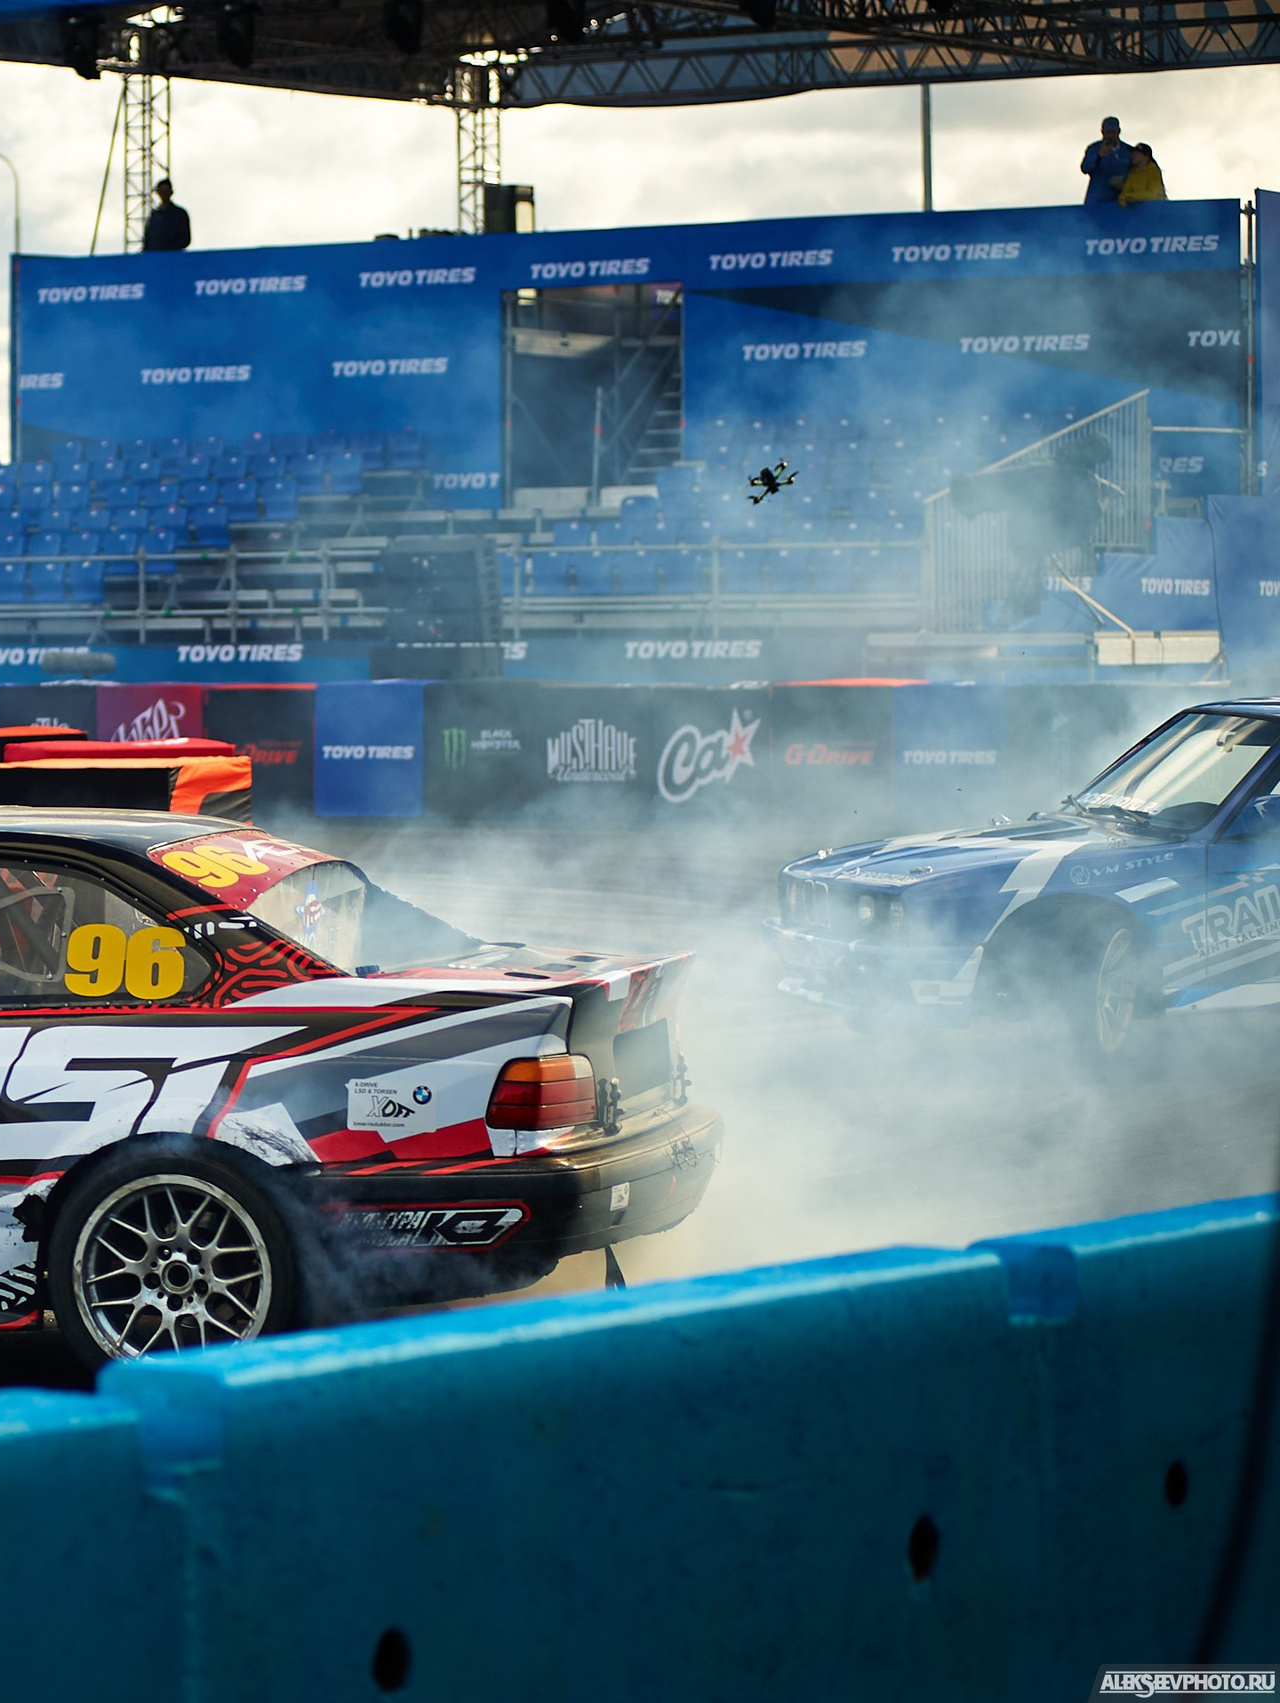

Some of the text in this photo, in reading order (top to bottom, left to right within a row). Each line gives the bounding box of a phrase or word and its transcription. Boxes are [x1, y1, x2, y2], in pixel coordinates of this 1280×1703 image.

[891, 242, 1021, 263] TOYO TIRES
[1085, 235, 1219, 255] TOYO TIRES
[530, 257, 651, 279] TOYO TIRES
[709, 249, 834, 271] TOYO TIRES
[194, 275, 308, 296] TOYO TIRES
[359, 266, 476, 288] TOYO TIRES
[37, 283, 146, 304] TOYO TIRES
[743, 340, 867, 361] TOYO TIRES
[959, 334, 1091, 353] TOYO TIRES
[141, 364, 253, 385] TOYO TIRES
[332, 357, 449, 377] TOYO TIRES
[433, 472, 486, 490] TOYO
[1141, 577, 1210, 595] TOYO TIRES
[178, 643, 304, 663] TOYO TIRES
[625, 640, 763, 659] TOYO TIRES
[322, 745, 414, 760] TOYO TIRES
[903, 749, 998, 765] TOYO TIRES
[161, 845, 270, 888] 96
[1091, 852, 1175, 877] VM STYLE
[65, 922, 187, 1000] 96
